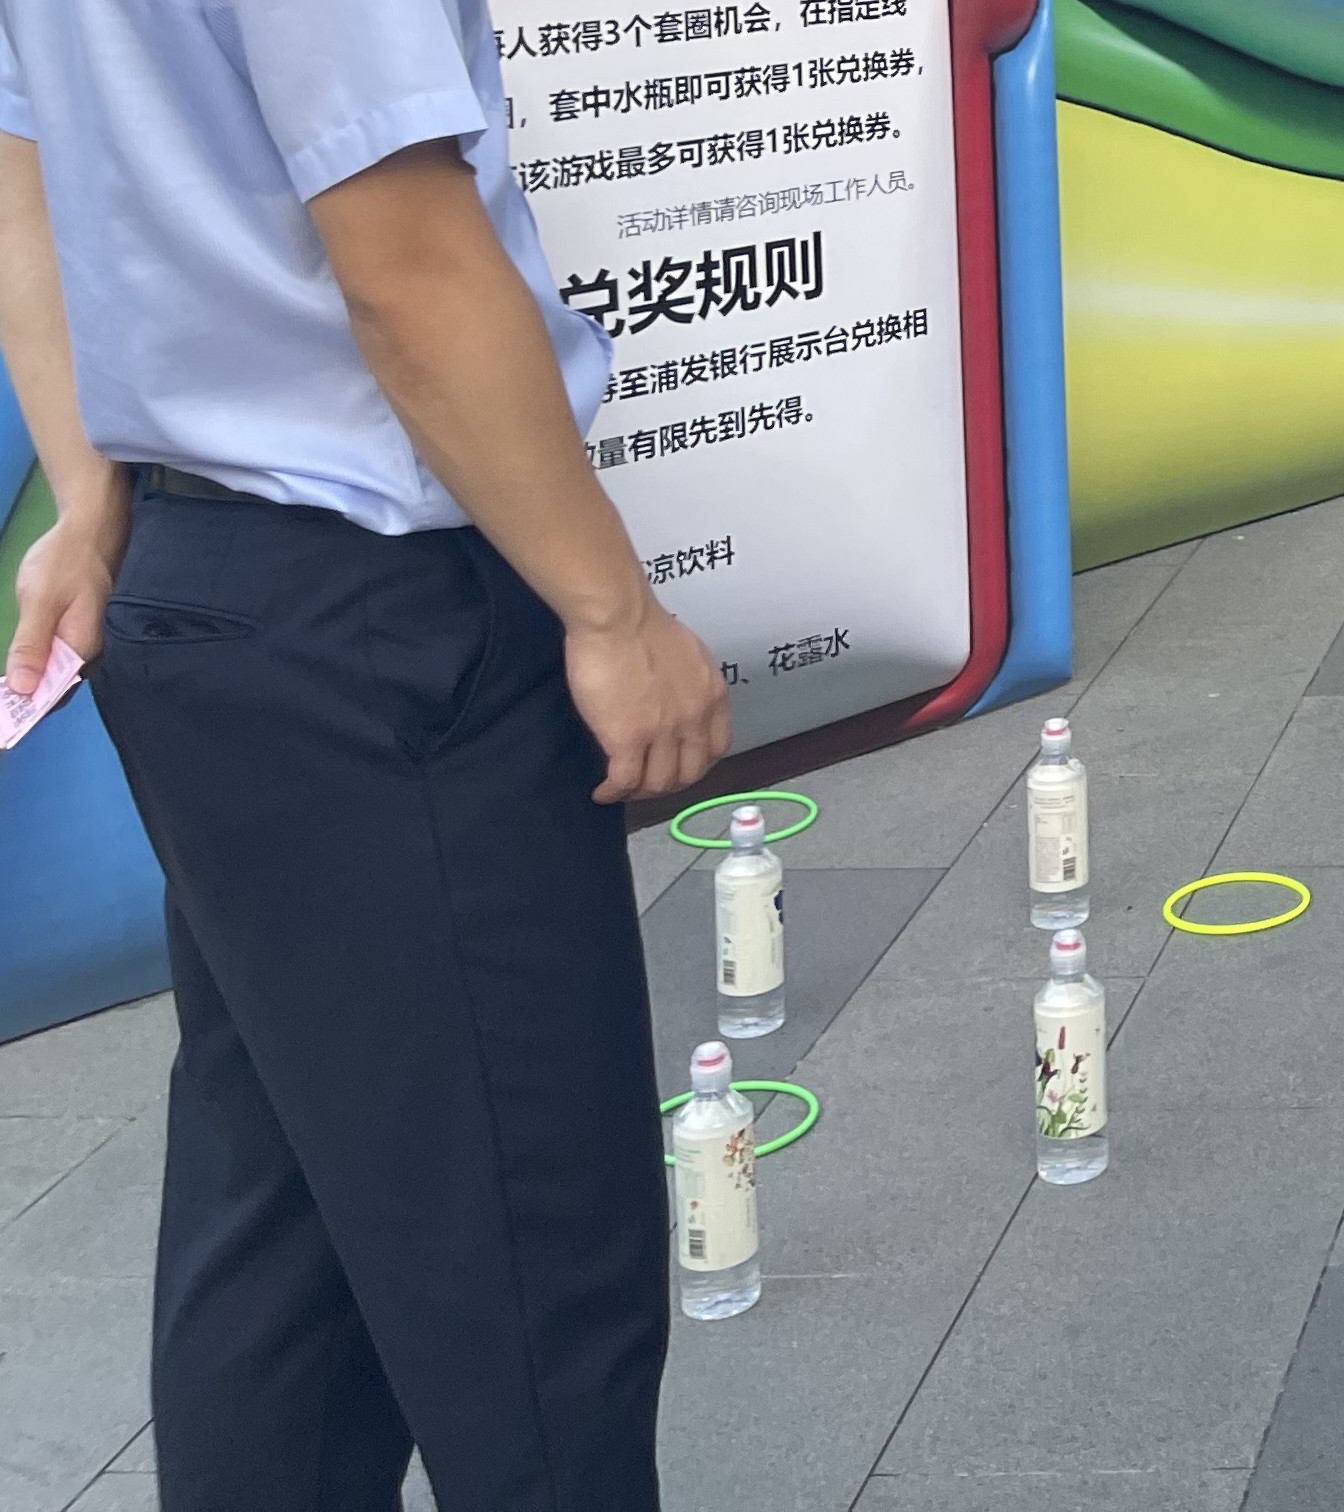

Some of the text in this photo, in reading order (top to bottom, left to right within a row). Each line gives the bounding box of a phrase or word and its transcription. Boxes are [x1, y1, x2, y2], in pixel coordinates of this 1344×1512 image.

[511, 112, 904, 195] 该游戏最多可获得1张兑换券。
[617, 170, 918, 240] 活动详情请咨询现场工作人员。
[560, 231, 825, 339] 兑奖规则
[640, 534, 736, 586] 凉饮料
